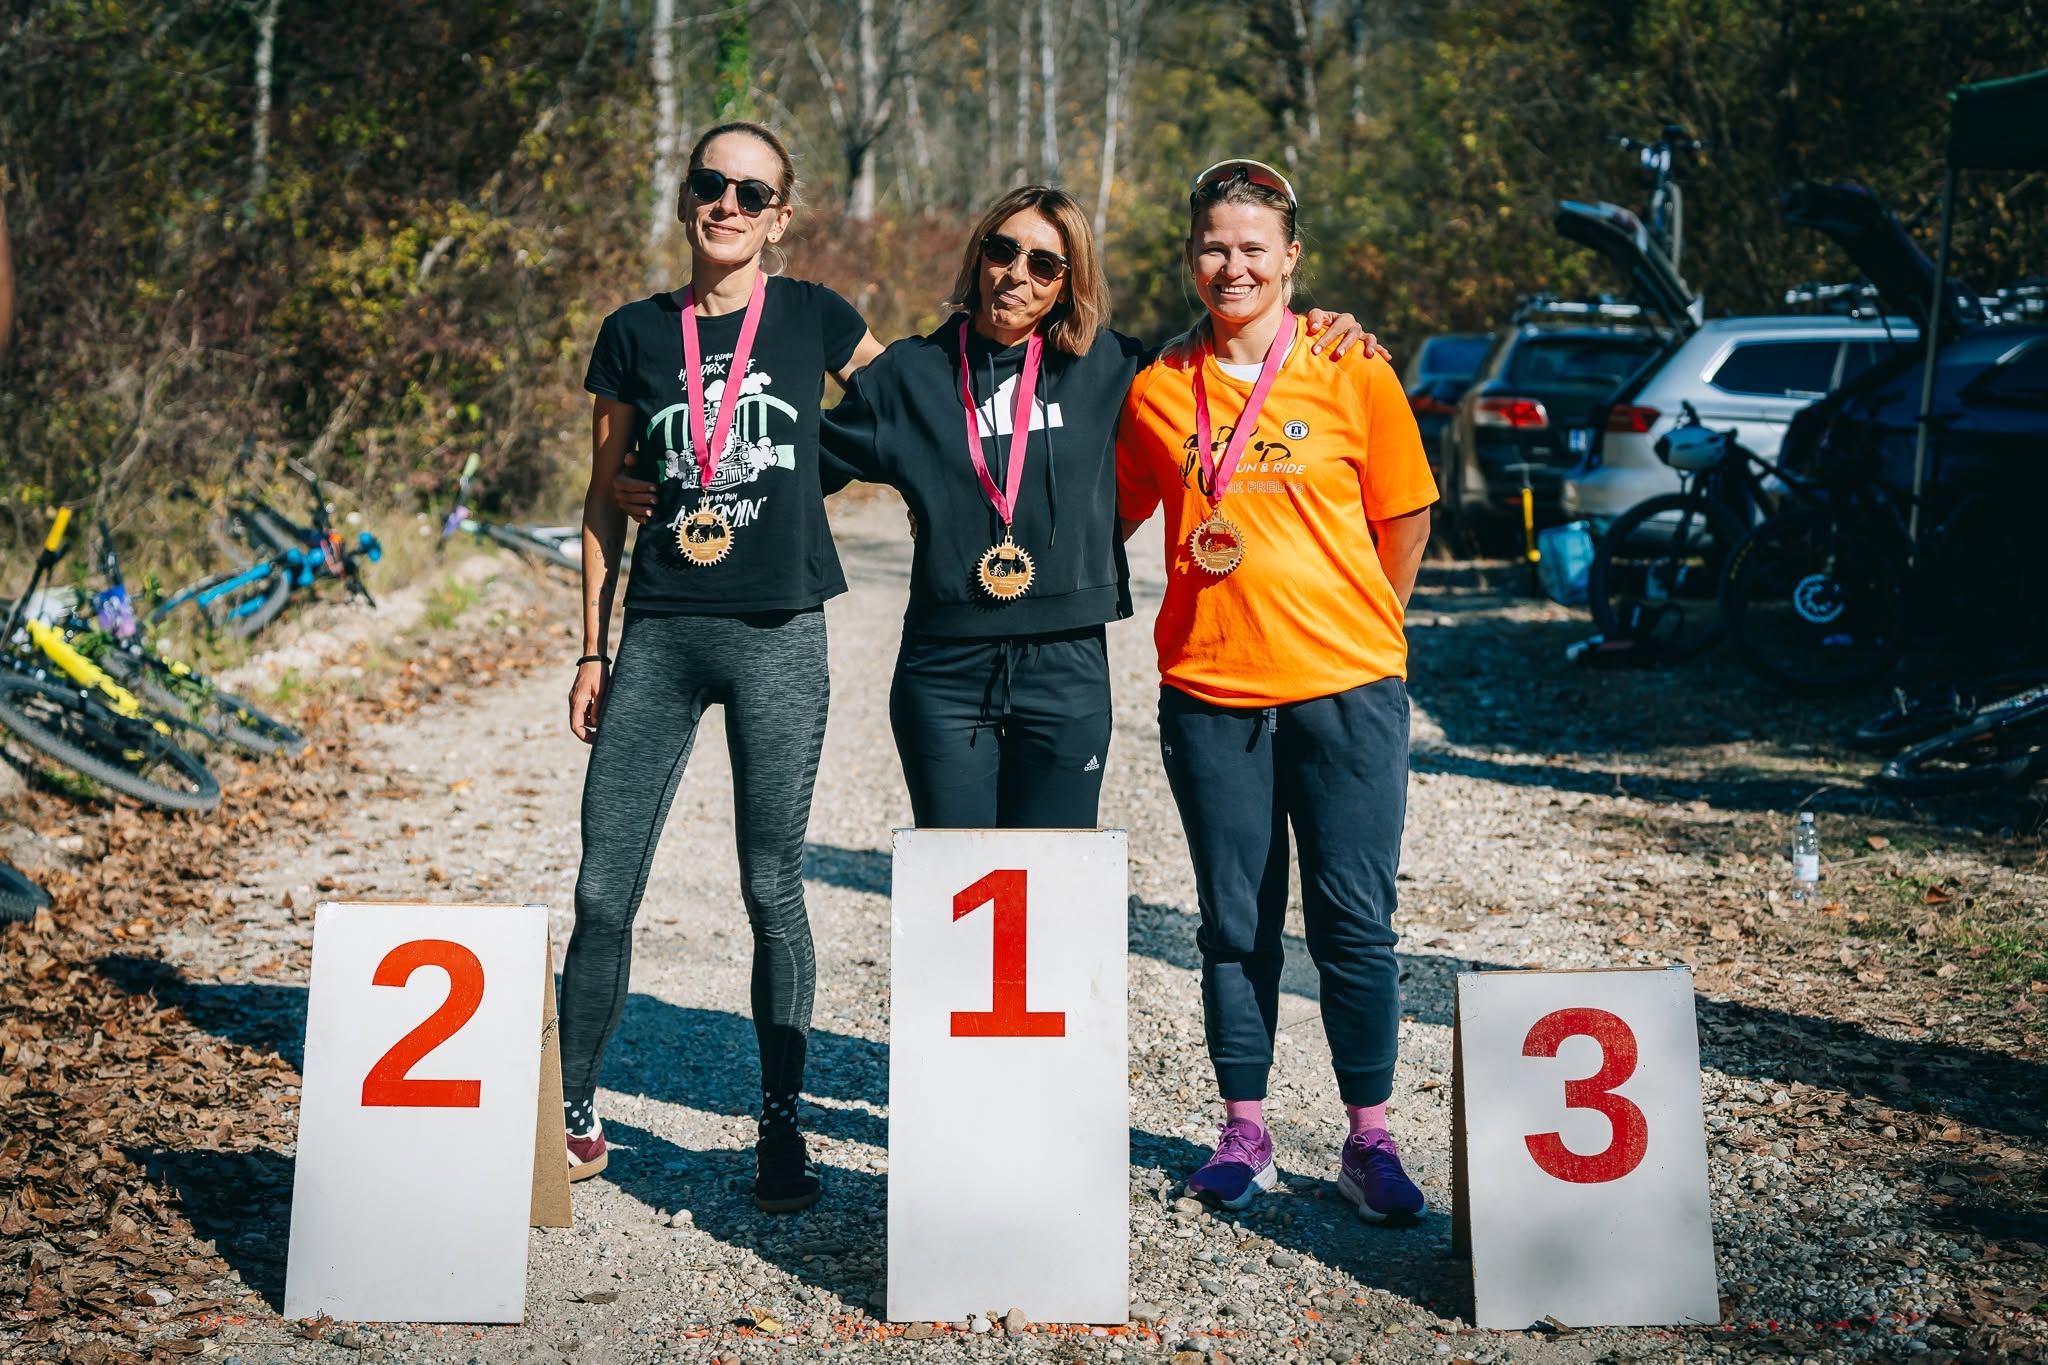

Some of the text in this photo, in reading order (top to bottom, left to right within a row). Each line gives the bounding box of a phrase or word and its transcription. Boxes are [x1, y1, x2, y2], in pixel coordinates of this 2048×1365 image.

[1235, 462, 1307, 475] UN & RIDE
[361, 939, 485, 1108] 2
[950, 869, 1066, 1038] 1
[1524, 1007, 1648, 1184] 3
